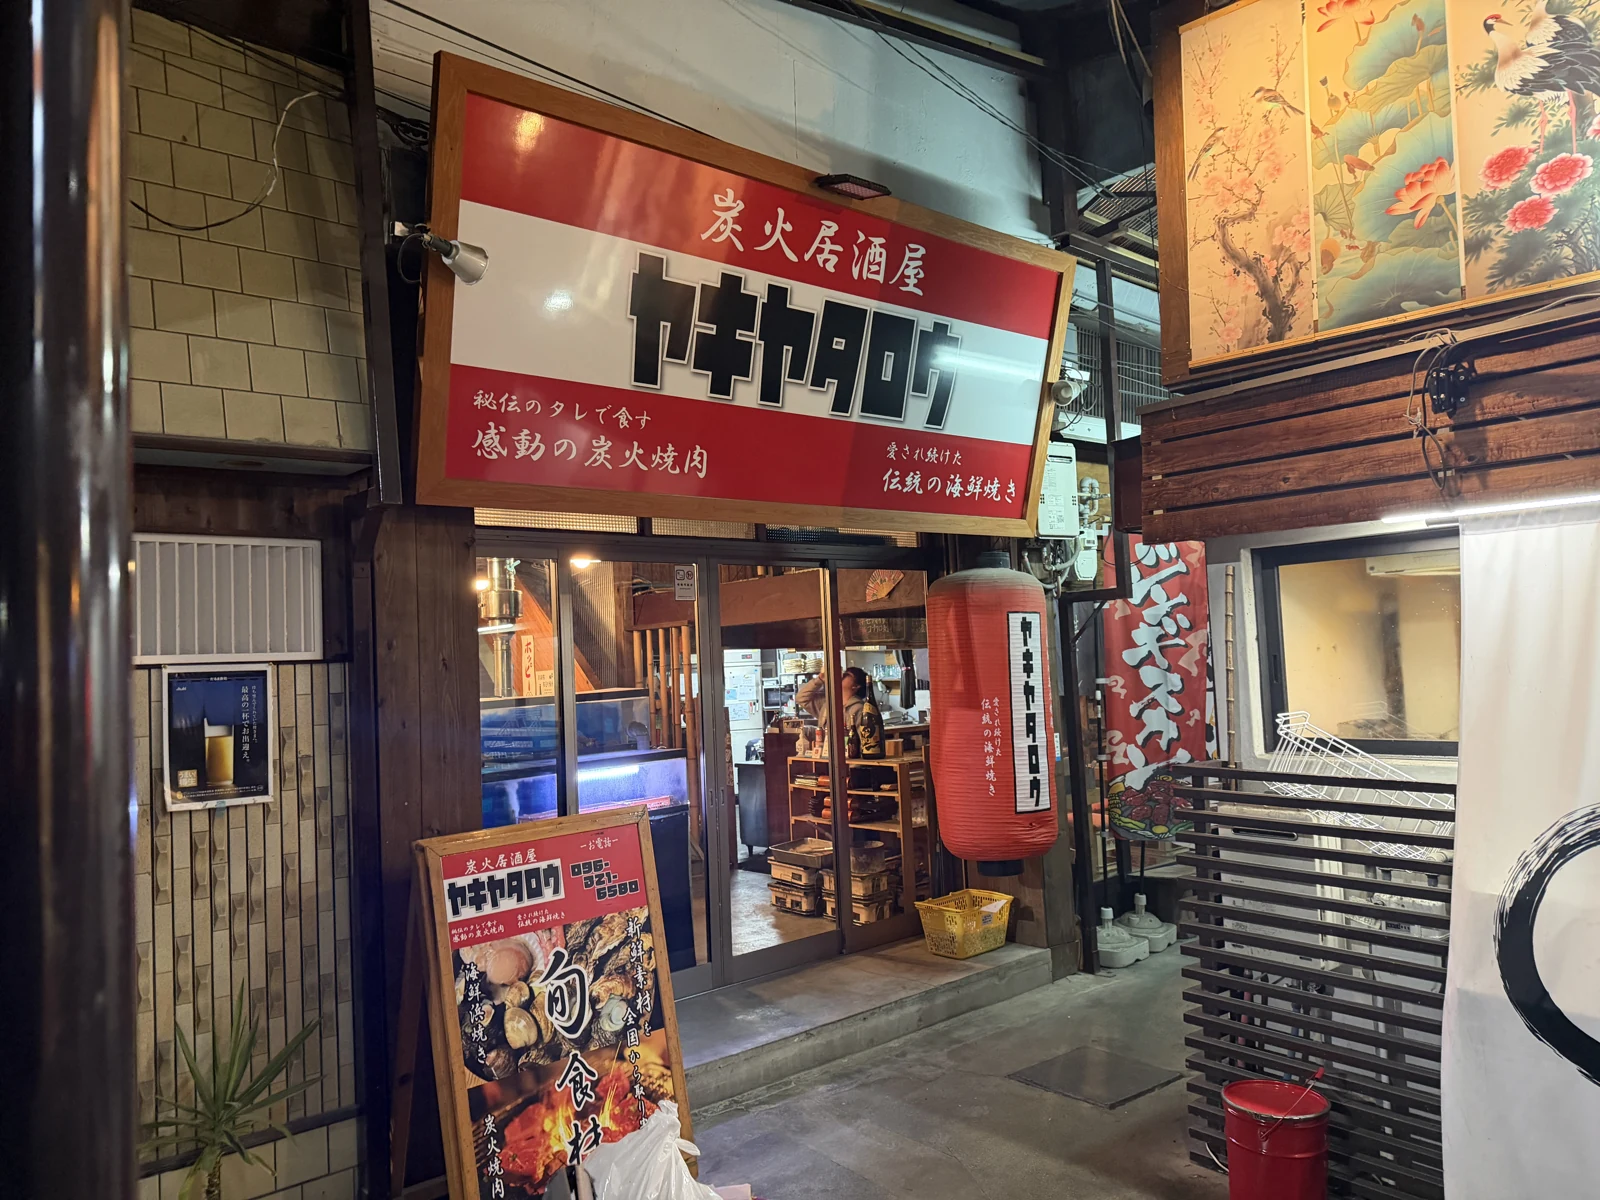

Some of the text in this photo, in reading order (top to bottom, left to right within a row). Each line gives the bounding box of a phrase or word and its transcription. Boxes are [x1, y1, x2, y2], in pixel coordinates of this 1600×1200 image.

[701, 188, 926, 296] 炭火居酒屋
[628, 250, 961, 429] ヤキヤタロウ
[473, 389, 651, 430] 秘伝のタレで食す
[472, 421, 707, 479] 感動の炭火焼肉
[886, 441, 962, 466] 愛され続けた
[882, 467, 1016, 503] 伝統の海鮮焼き
[464, 848, 538, 875] 炭火居酒屋
[464, 962, 488, 1065] 海鮮浜焼き
[482, 1114, 506, 1199] 炭火焼肉
